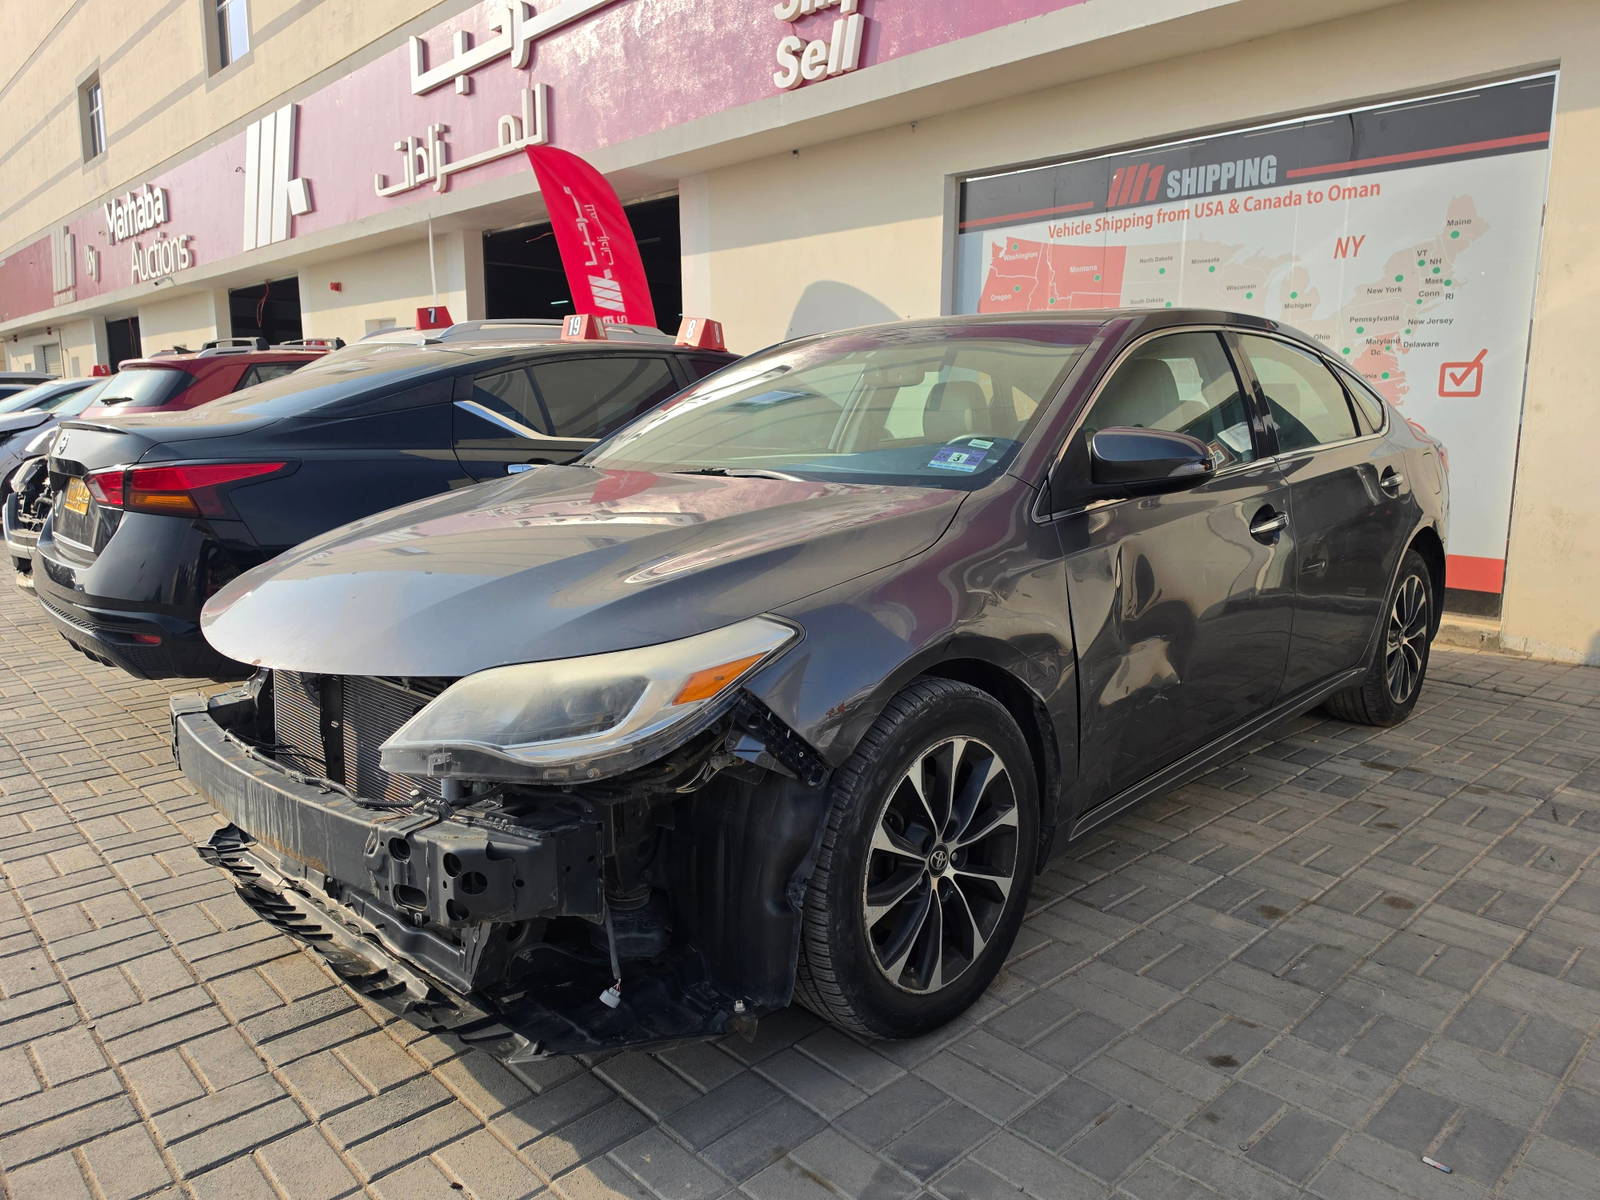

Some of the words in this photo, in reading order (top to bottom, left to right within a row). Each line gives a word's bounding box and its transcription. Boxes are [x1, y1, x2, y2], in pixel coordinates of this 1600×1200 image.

[409, 0, 616, 95] رحبا
[773, 13, 863, 89] Sell
[375, 83, 549, 197] للمزادات
[1166, 155, 1277, 199] SHIPPING
[104, 183, 168, 245] Marhaba
[1048, 220, 1091, 239] Vehicle
[1095, 213, 1153, 233] Shipping
[1157, 208, 1190, 224] from
[1194, 200, 1224, 218] USA
[1228, 198, 1239, 214] &
[1244, 191, 1302, 212] Canada
[1306, 189, 1323, 204] to
[1328, 184, 1381, 201] Oman
[1446, 218, 1472, 227] Maine
[1333, 235, 1366, 260] NY
[1416, 249, 1428, 257] VT
[131, 232, 193, 284] Auctions
[1418, 289, 1440, 297] Conn
[427, 307, 436, 323] 7
[1284, 302, 1312, 311] Michigan
[568, 316, 581, 336] 19
[686, 319, 696, 339] 8
[1349, 315, 1400, 324] Pennsylvania
[1427, 317, 1454, 326] Jersey
[1365, 337, 1401, 346] Maryland
[952, 454, 962, 462] 3
